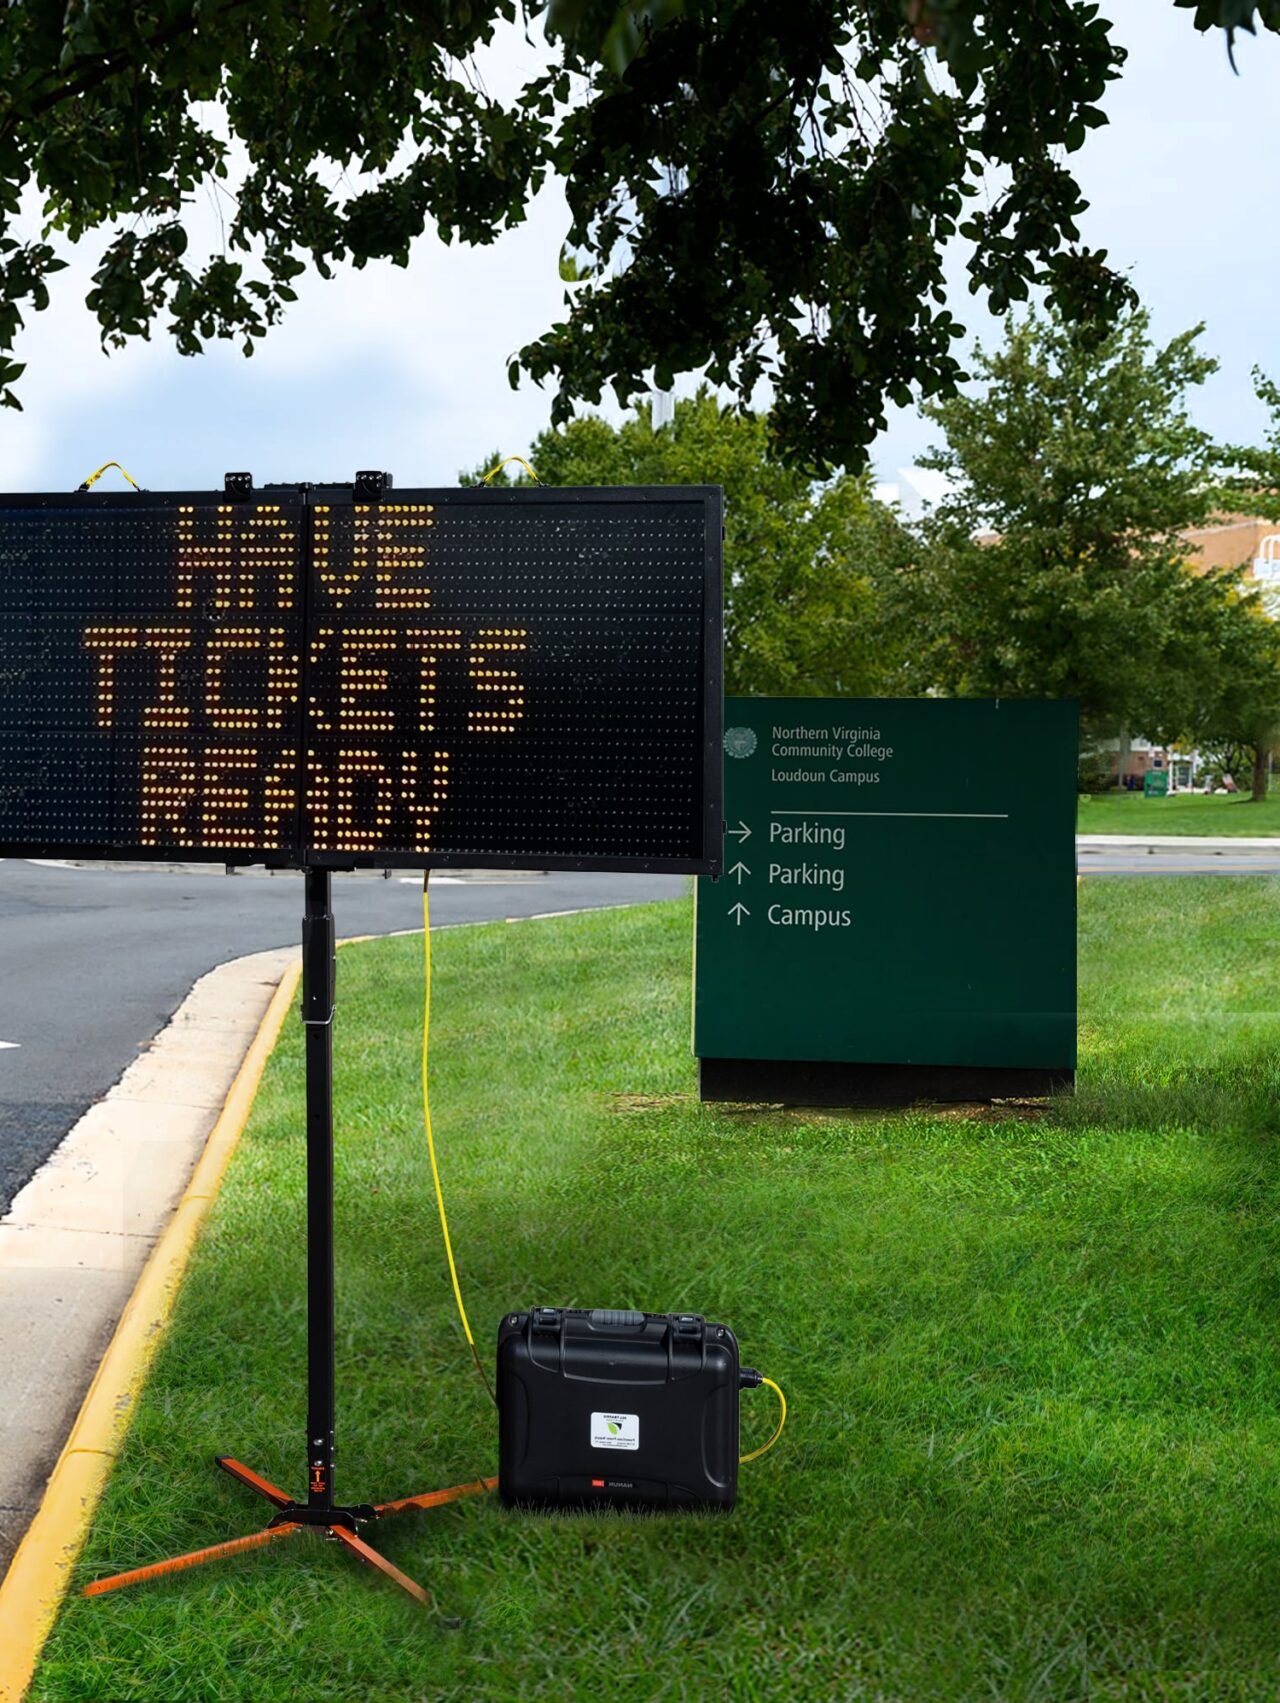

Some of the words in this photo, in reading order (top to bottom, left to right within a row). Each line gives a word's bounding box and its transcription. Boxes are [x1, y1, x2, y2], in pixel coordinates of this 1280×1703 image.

[178, 504, 435, 609] HAVE
[83, 626, 528, 731] TICKETS
[772, 726, 829, 740] Northern
[832, 726, 881, 744] Virginia
[771, 743, 844, 761] Community
[846, 743, 894, 762] College
[771, 768, 826, 782] Loudoun
[829, 769, 881, 786] Campus
[141, 746, 450, 853] READY
[770, 821, 846, 850] Parking
[769, 862, 845, 891] Parking
[767, 904, 852, 932] Campus
